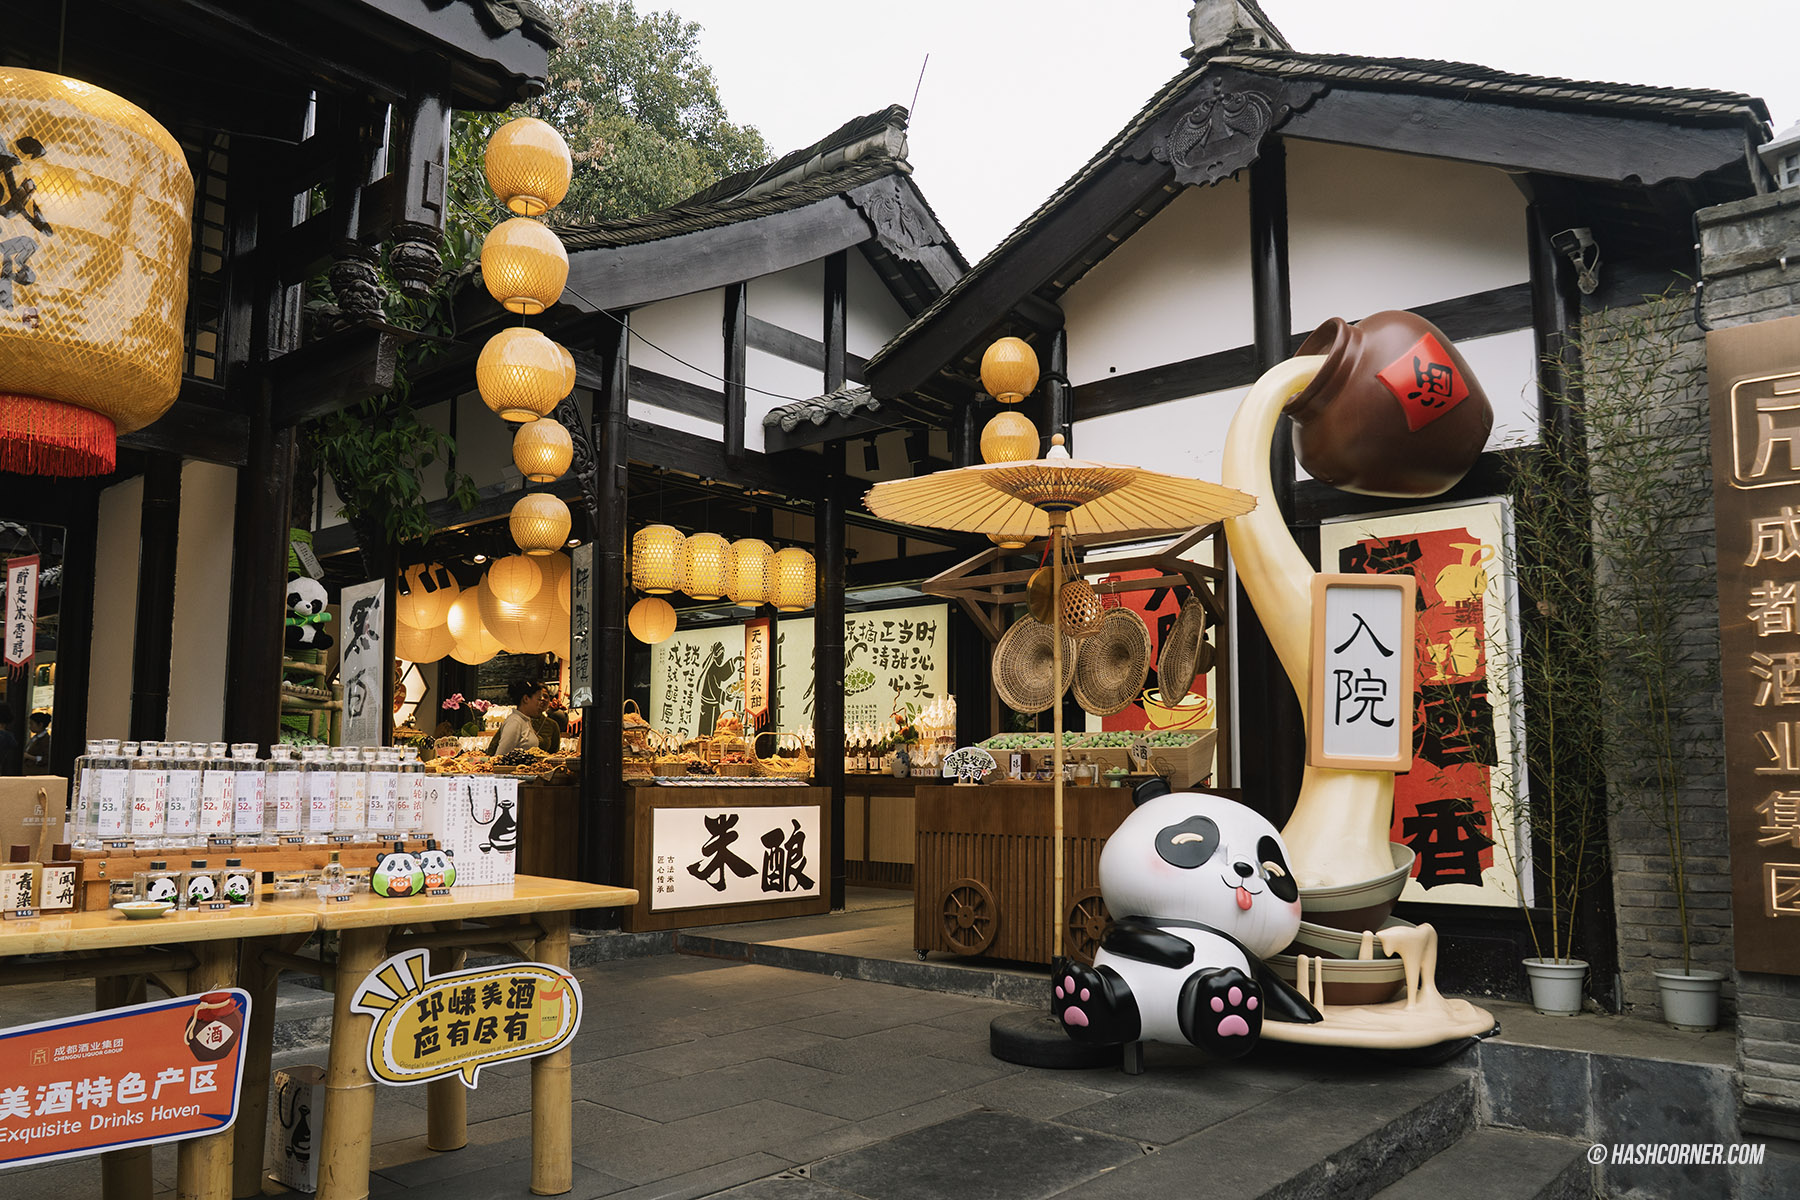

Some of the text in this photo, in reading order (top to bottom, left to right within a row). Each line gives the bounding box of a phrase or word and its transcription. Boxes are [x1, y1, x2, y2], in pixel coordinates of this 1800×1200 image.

[1333, 613, 1395, 728] 入院
[686, 813, 816, 893] 米酿
[417, 977, 537, 1024] 邛崃美酒
[53, 1038, 124, 1057] 成都酒业集团
[53, 1053, 82, 1062] CHENGDU
[82, 1050, 103, 1058] LIQUOR
[205, 1026, 223, 1045] 酒
[413, 1011, 530, 1059] 应有尽有
[0, 1064, 218, 1121] 美酒特色产区
[0, 1104, 200, 1144] Exquisite Drinks Haven
